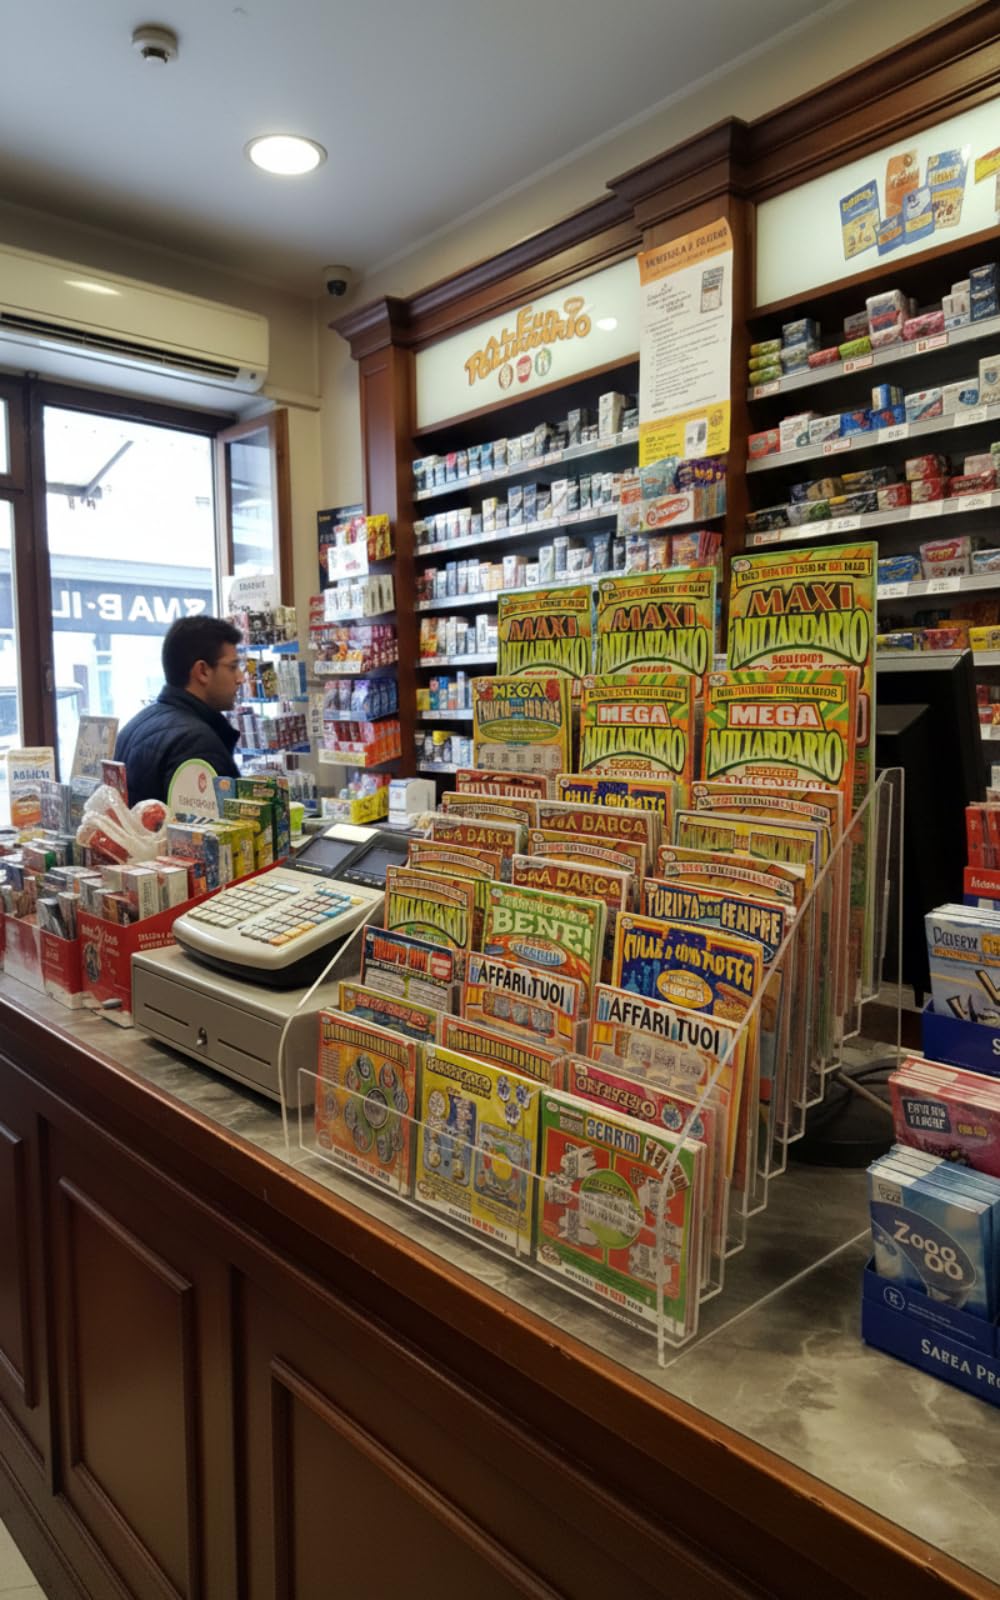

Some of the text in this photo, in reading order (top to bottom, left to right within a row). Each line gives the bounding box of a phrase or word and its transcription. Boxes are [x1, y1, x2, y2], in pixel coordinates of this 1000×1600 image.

[747, 583, 853, 617] MAXI
[508, 615, 577, 641] MAXI
[611, 604, 696, 631] MAXI
[492, 682, 544, 699] MEGA
[600, 705, 667, 723] MEGA
[731, 705, 819, 726] MEGA
[491, 904, 592, 963] BENE!
[476, 960, 526, 995] AFFARI
[608, 997, 720, 1055] AFFARI TUOI
